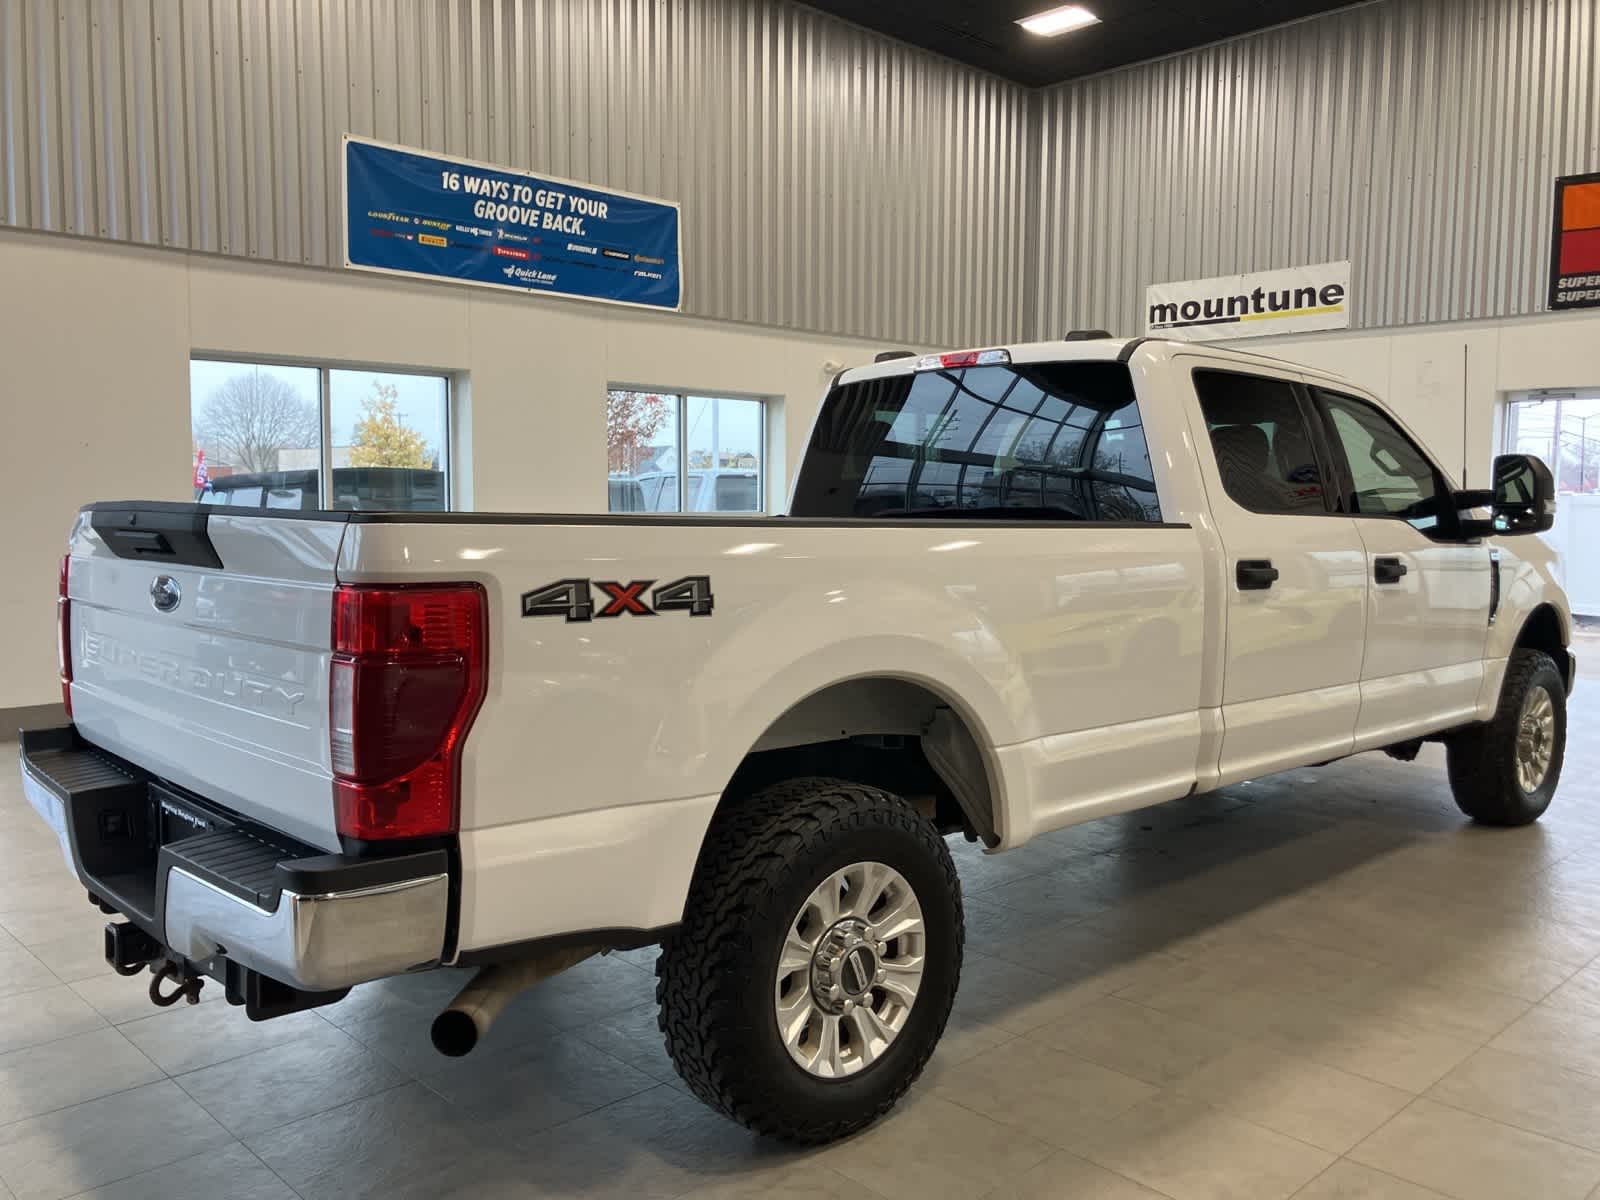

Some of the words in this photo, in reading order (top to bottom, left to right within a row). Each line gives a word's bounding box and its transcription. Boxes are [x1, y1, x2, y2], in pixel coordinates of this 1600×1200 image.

[441, 171, 461, 191] 16
[463, 175, 510, 200] WAYS
[512, 184, 533, 205] TO
[535, 189, 566, 210] GET
[569, 195, 609, 220] YOUR
[473, 200, 541, 228] GROOVE
[542, 212, 587, 236] BACK.
[514, 267, 537, 279] Quick
[537, 271, 558, 281] Lane
[1149, 283, 1345, 324] mountune
